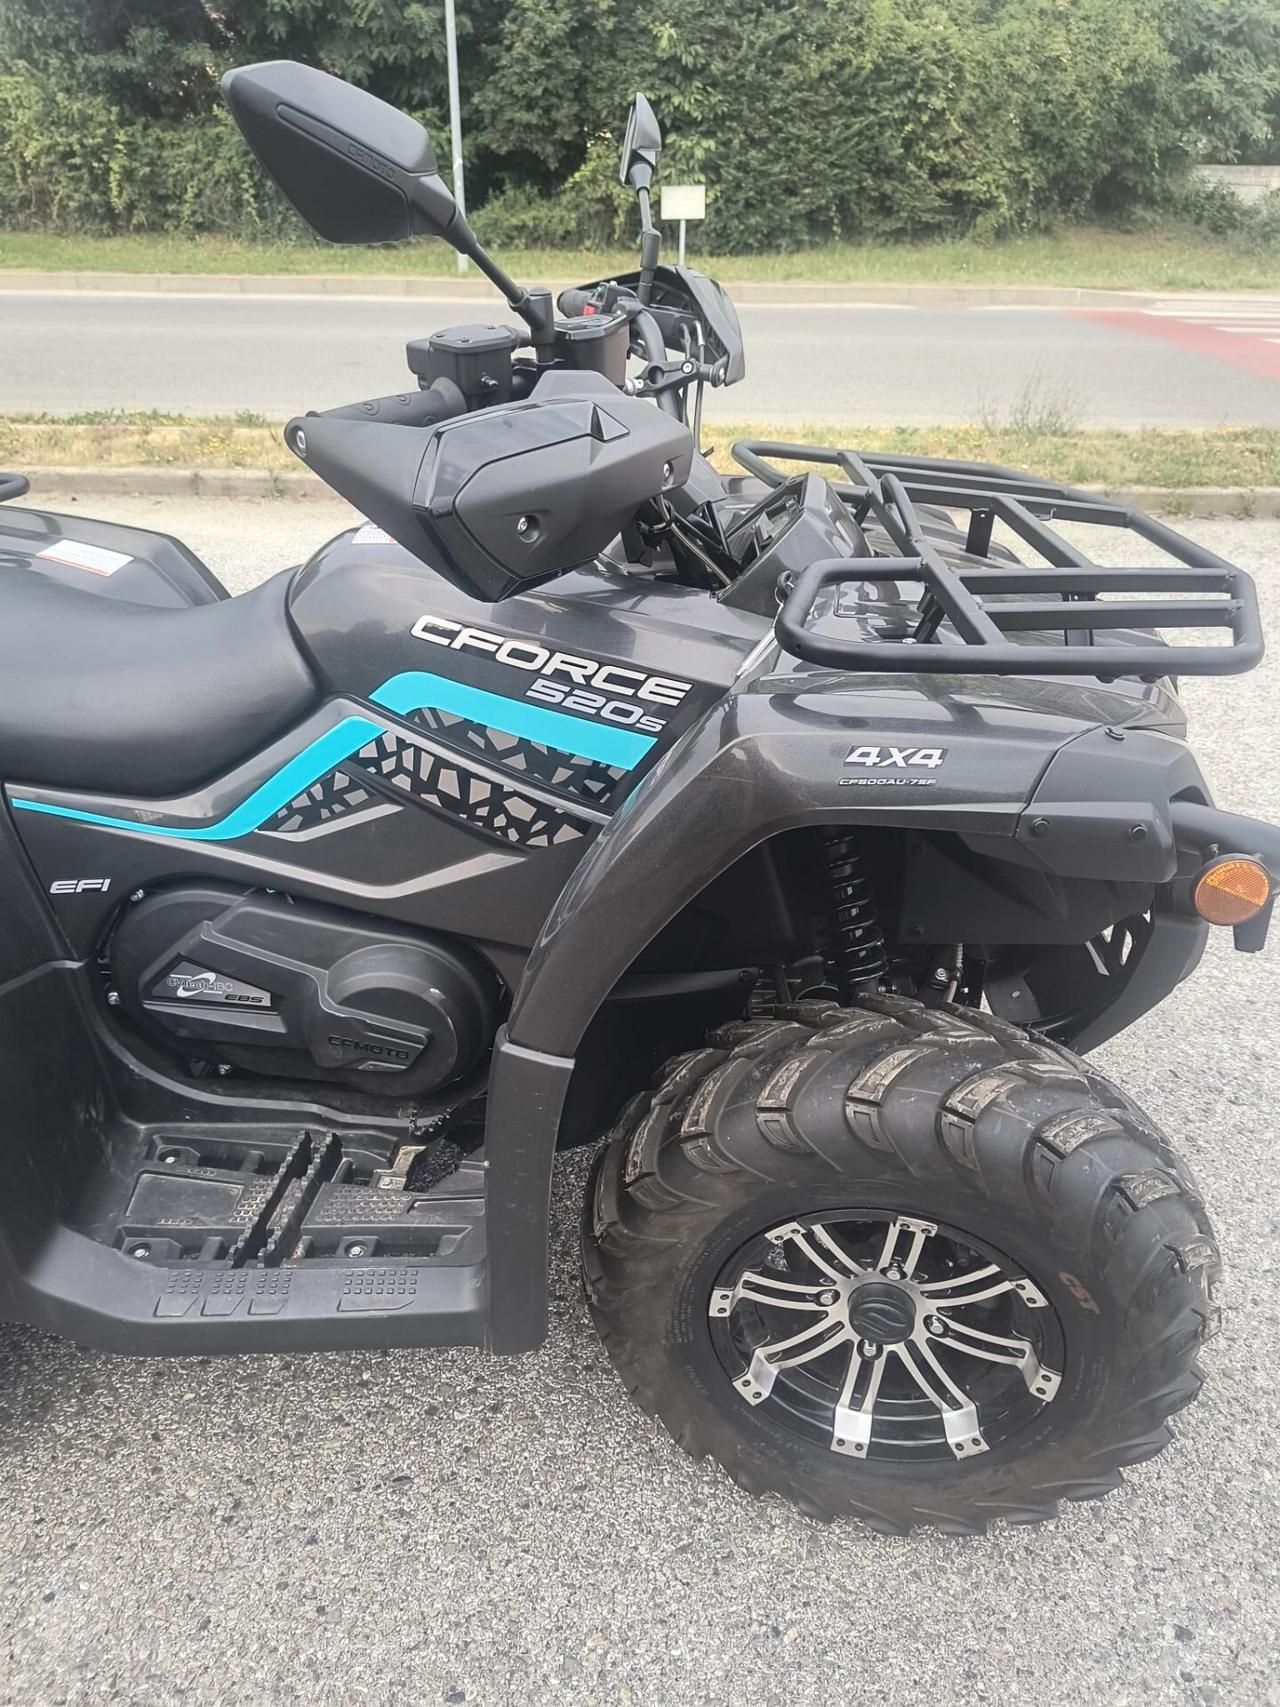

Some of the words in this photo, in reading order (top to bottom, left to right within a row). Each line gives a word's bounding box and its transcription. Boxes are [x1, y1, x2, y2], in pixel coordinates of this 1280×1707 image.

[410, 615, 693, 706] CFORCE
[50, 879, 111, 894] EFI
[224, 994, 264, 1004] EBS
[327, 1036, 409, 1060] CFMOTO
[1060, 1272, 1100, 1315] CST
